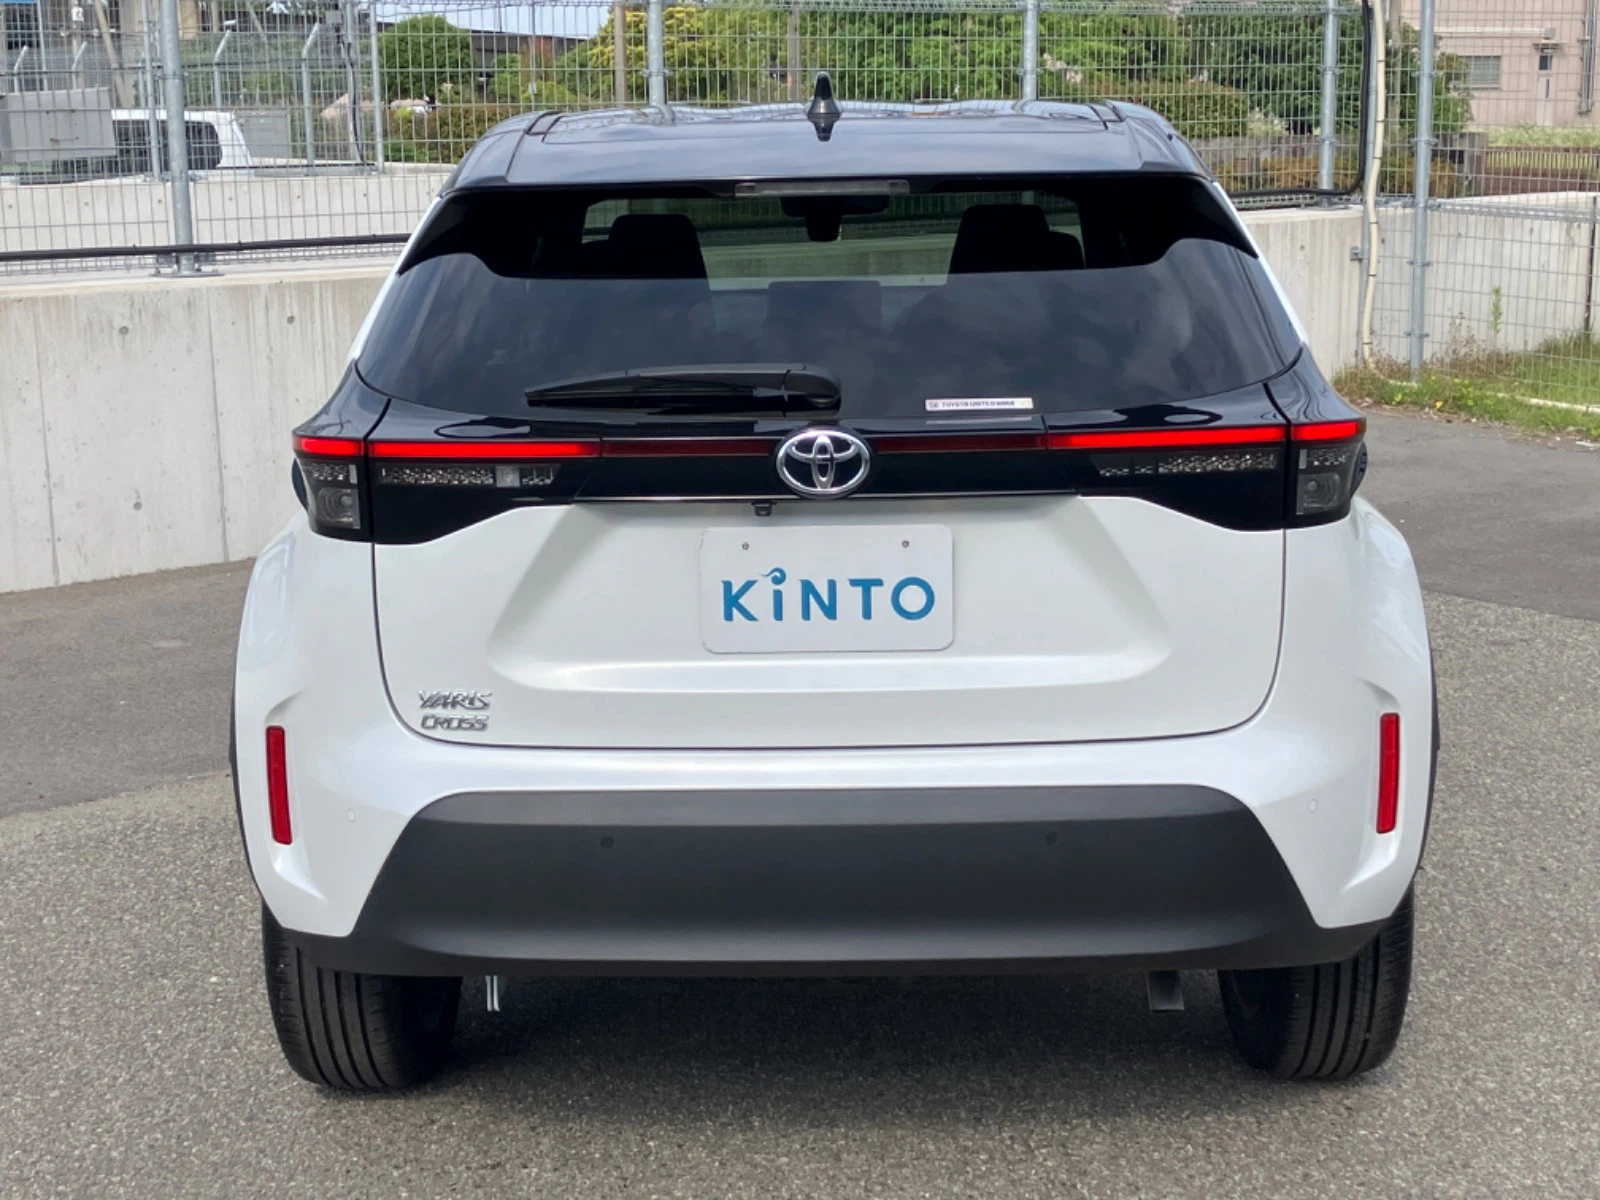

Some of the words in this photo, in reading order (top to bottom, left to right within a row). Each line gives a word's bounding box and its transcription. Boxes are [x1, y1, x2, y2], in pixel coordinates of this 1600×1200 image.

[941, 400, 969, 408] TOYOTA
[418, 690, 493, 710] YARIS
[421, 714, 489, 731] CROSS
